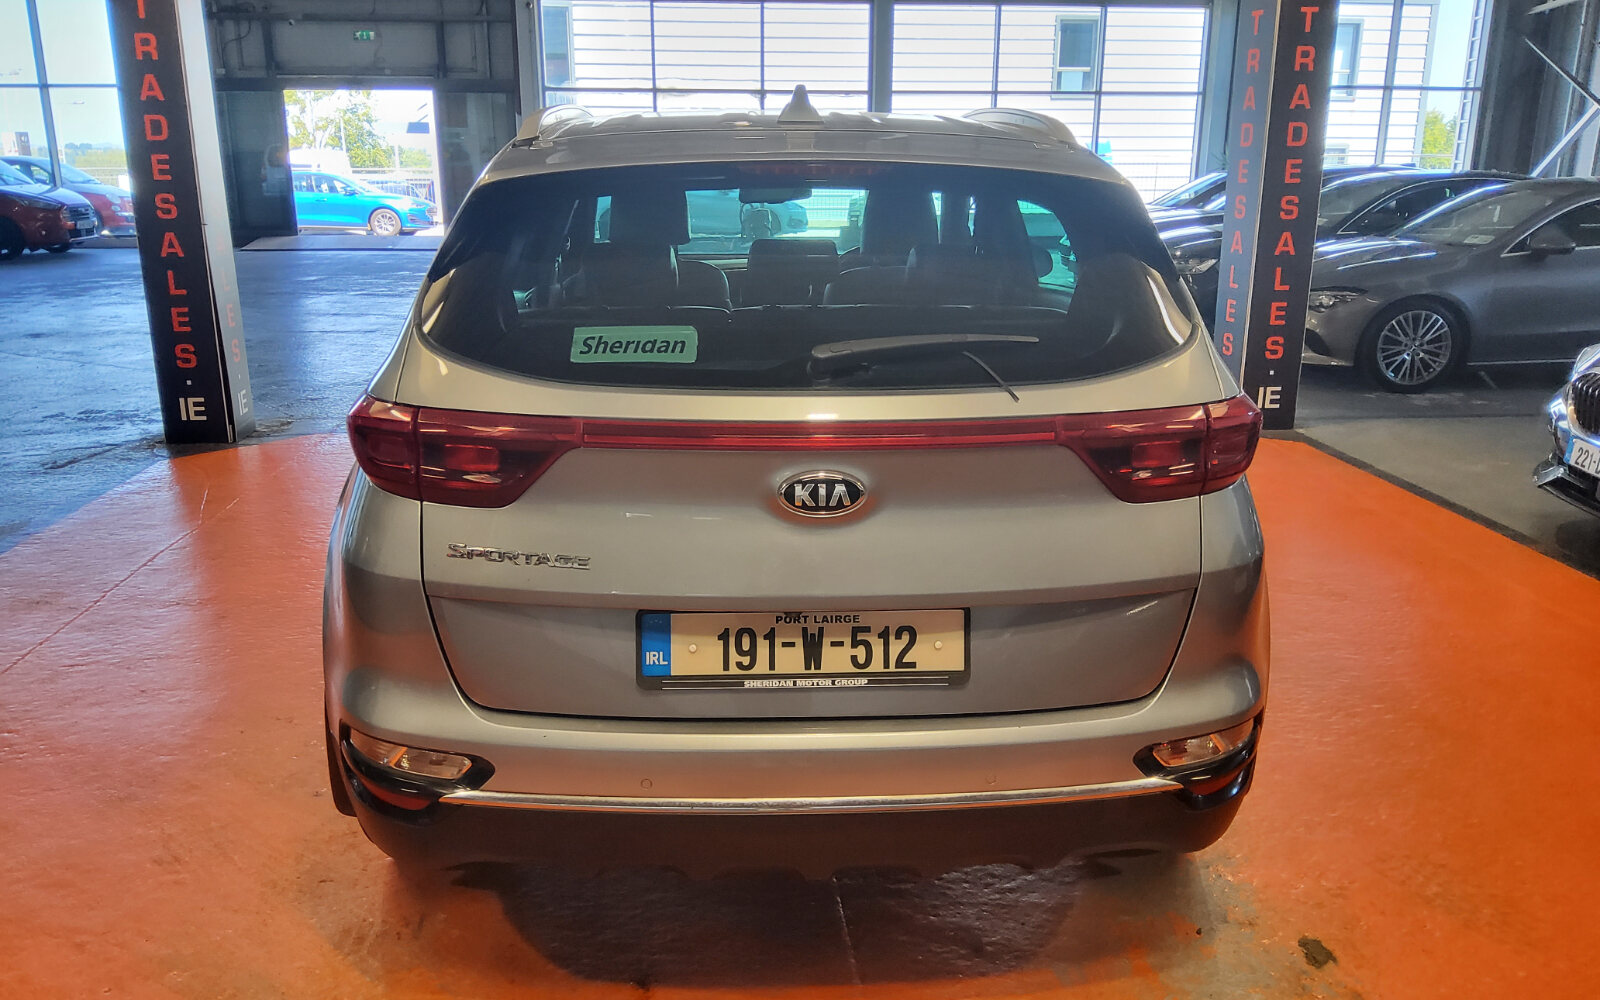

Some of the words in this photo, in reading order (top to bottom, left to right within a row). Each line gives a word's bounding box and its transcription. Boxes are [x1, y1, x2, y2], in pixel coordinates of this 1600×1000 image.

[579, 335, 686, 355] Sheridan
[793, 483, 852, 507] KIA
[446, 542, 592, 570] SPORTAGE
[775, 614, 809, 625] PORT
[813, 614, 861, 624] LAIRGE
[645, 651, 669, 666] IRL
[716, 625, 918, 672] 191-W-512
[743, 680, 794, 689] SHERIDAN
[796, 679, 833, 688] MOTOR
[834, 678, 869, 687] GROUP
